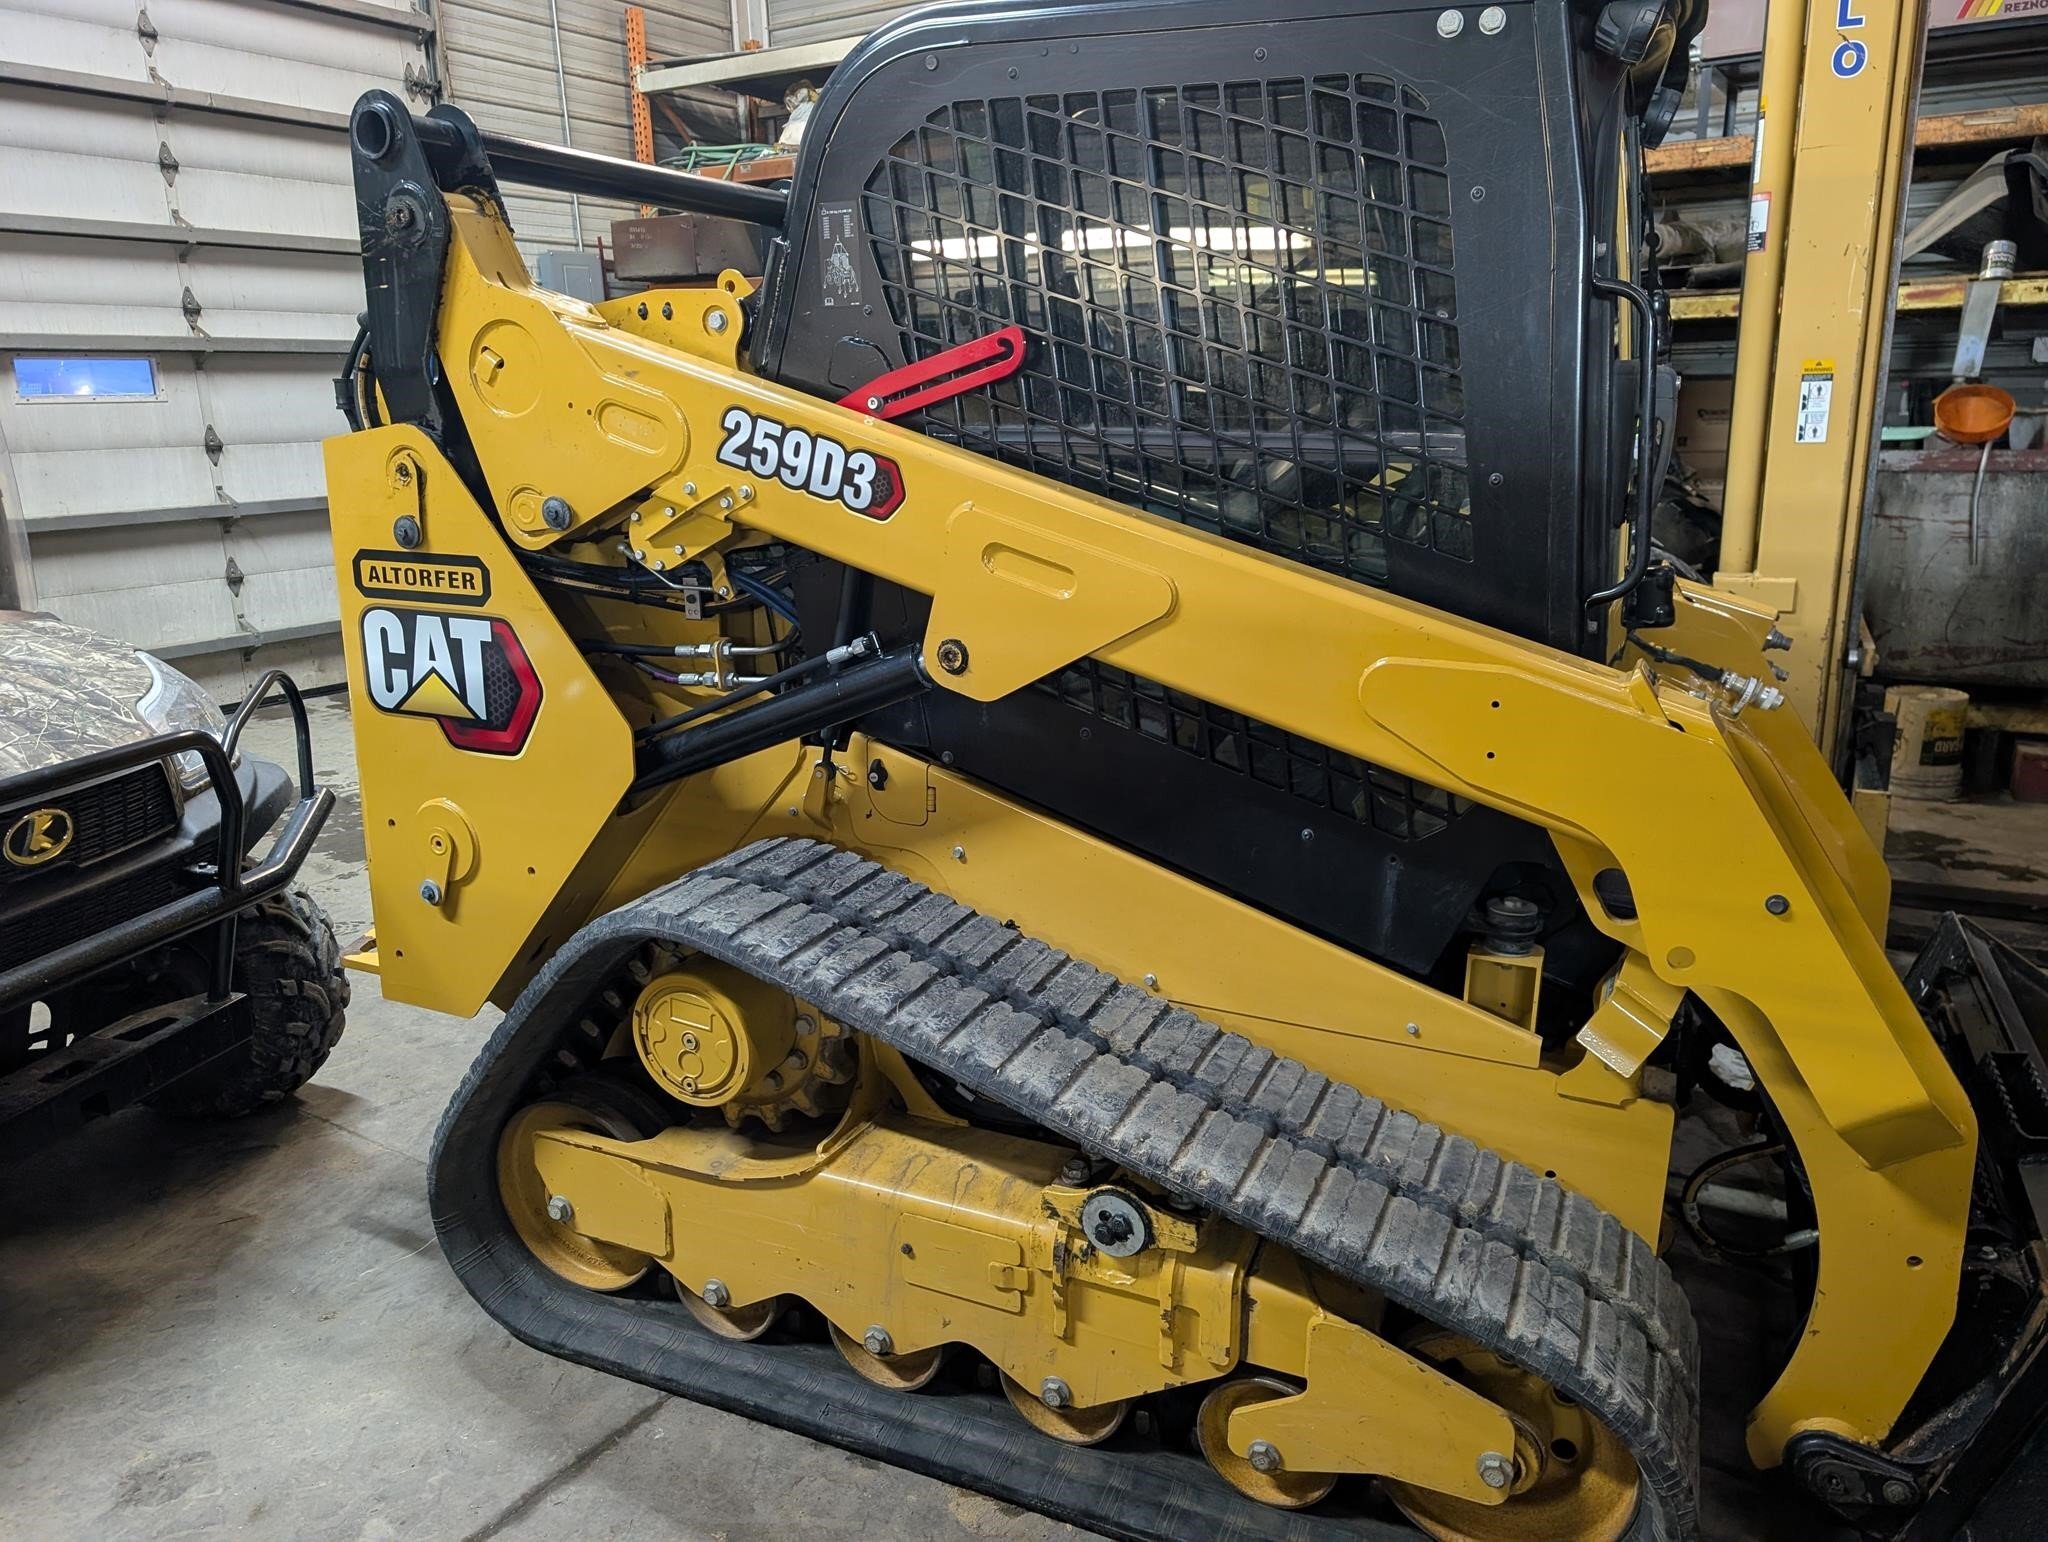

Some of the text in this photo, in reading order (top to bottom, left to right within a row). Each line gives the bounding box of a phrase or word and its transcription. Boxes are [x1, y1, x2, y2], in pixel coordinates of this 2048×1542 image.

[2004, 0, 2048, 13] REZNO
[719, 409, 877, 509] 259D3
[368, 566, 476, 590] ALTORFER
[364, 609, 492, 720] CAT
